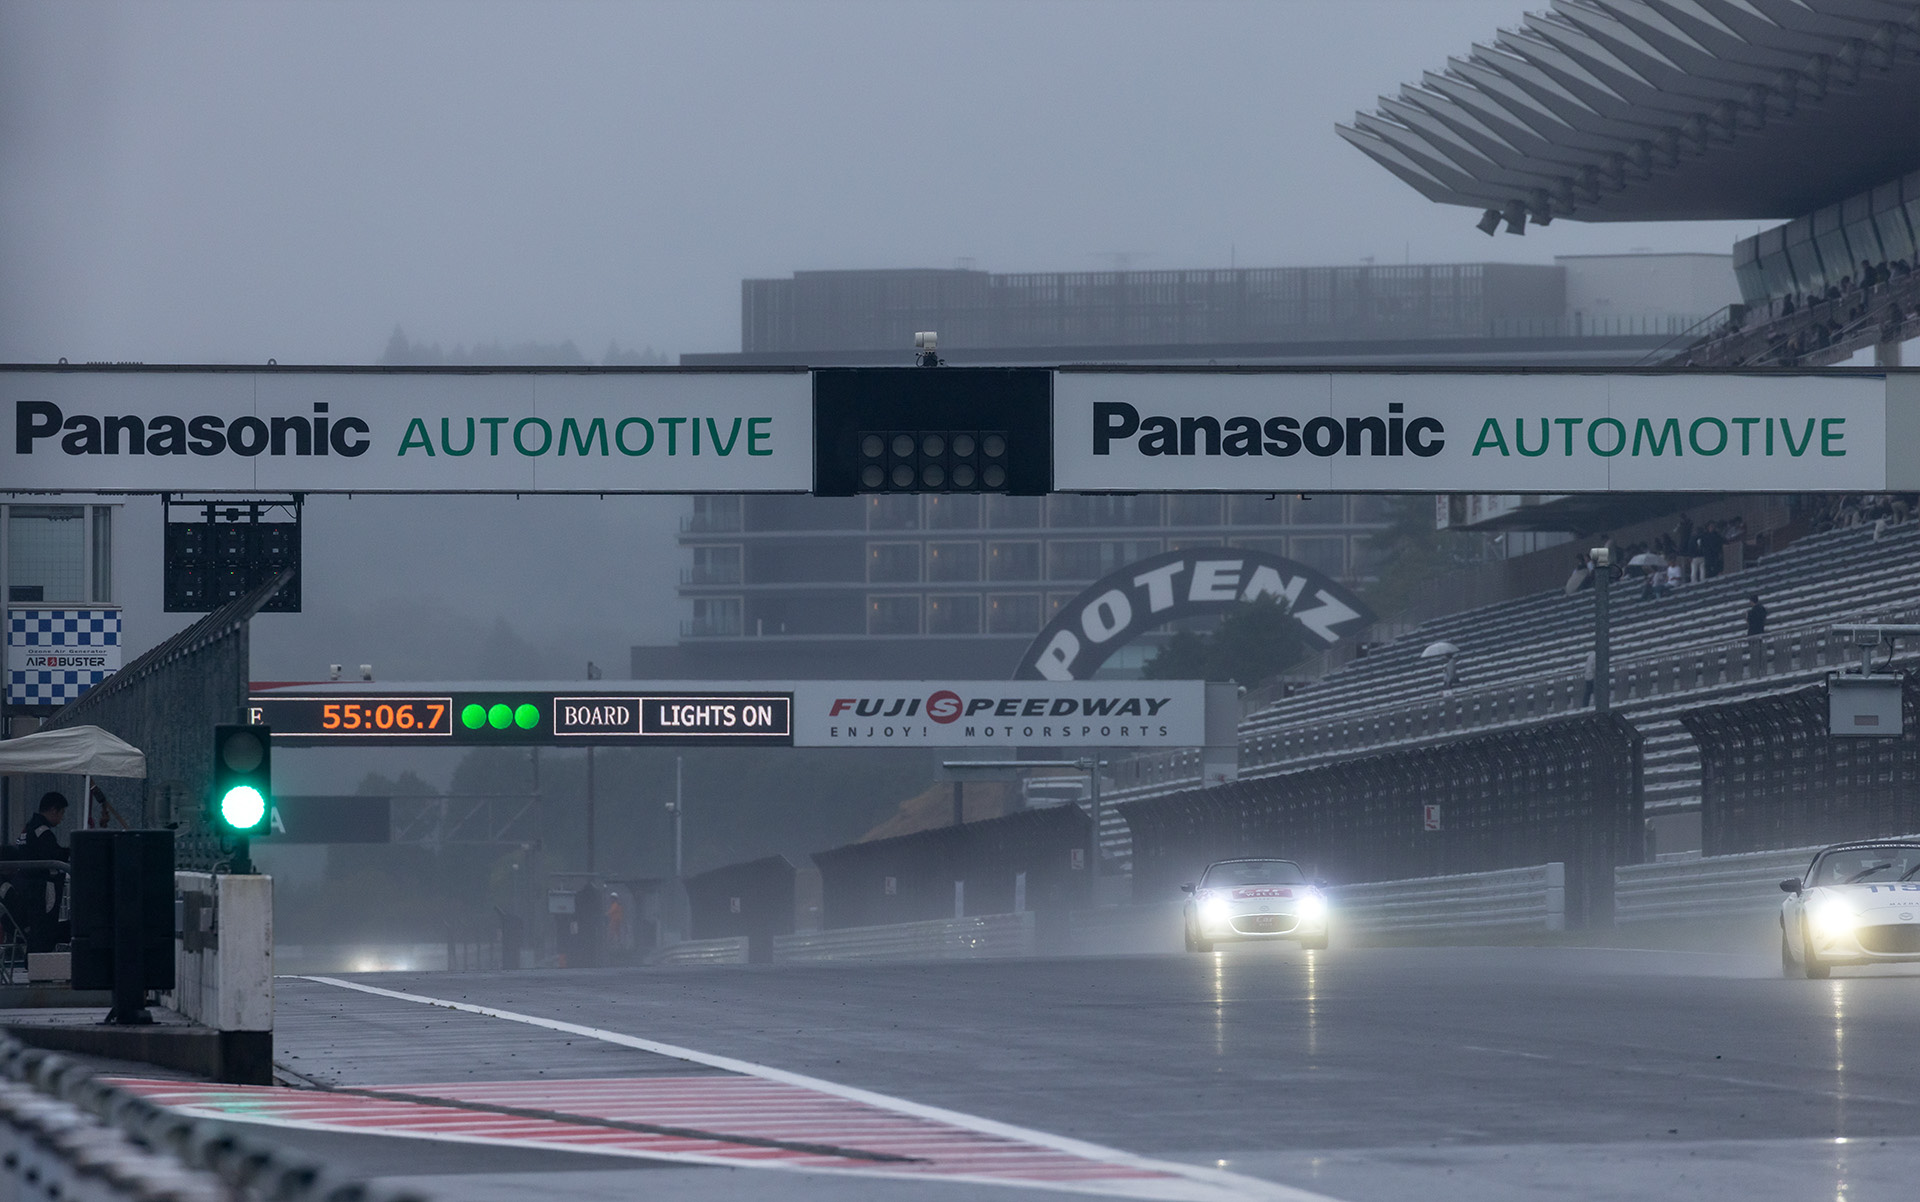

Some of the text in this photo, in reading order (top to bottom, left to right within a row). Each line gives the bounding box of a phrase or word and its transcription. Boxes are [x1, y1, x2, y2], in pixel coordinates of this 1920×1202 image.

[15, 400, 774, 457] Panasonic AUTOMOTIVE
[1093, 401, 1847, 457] Panasonic AUTOMOTIVE
[26, 657, 105, 667] AIR BUSTER
[247, 707, 264, 725] E
[322, 704, 445, 729] 55:06.7
[564, 706, 630, 726] BOARD
[660, 705, 772, 727] LIGHTS ON
[830, 726, 1168, 737] ENJOY! MOTORSPORTS
